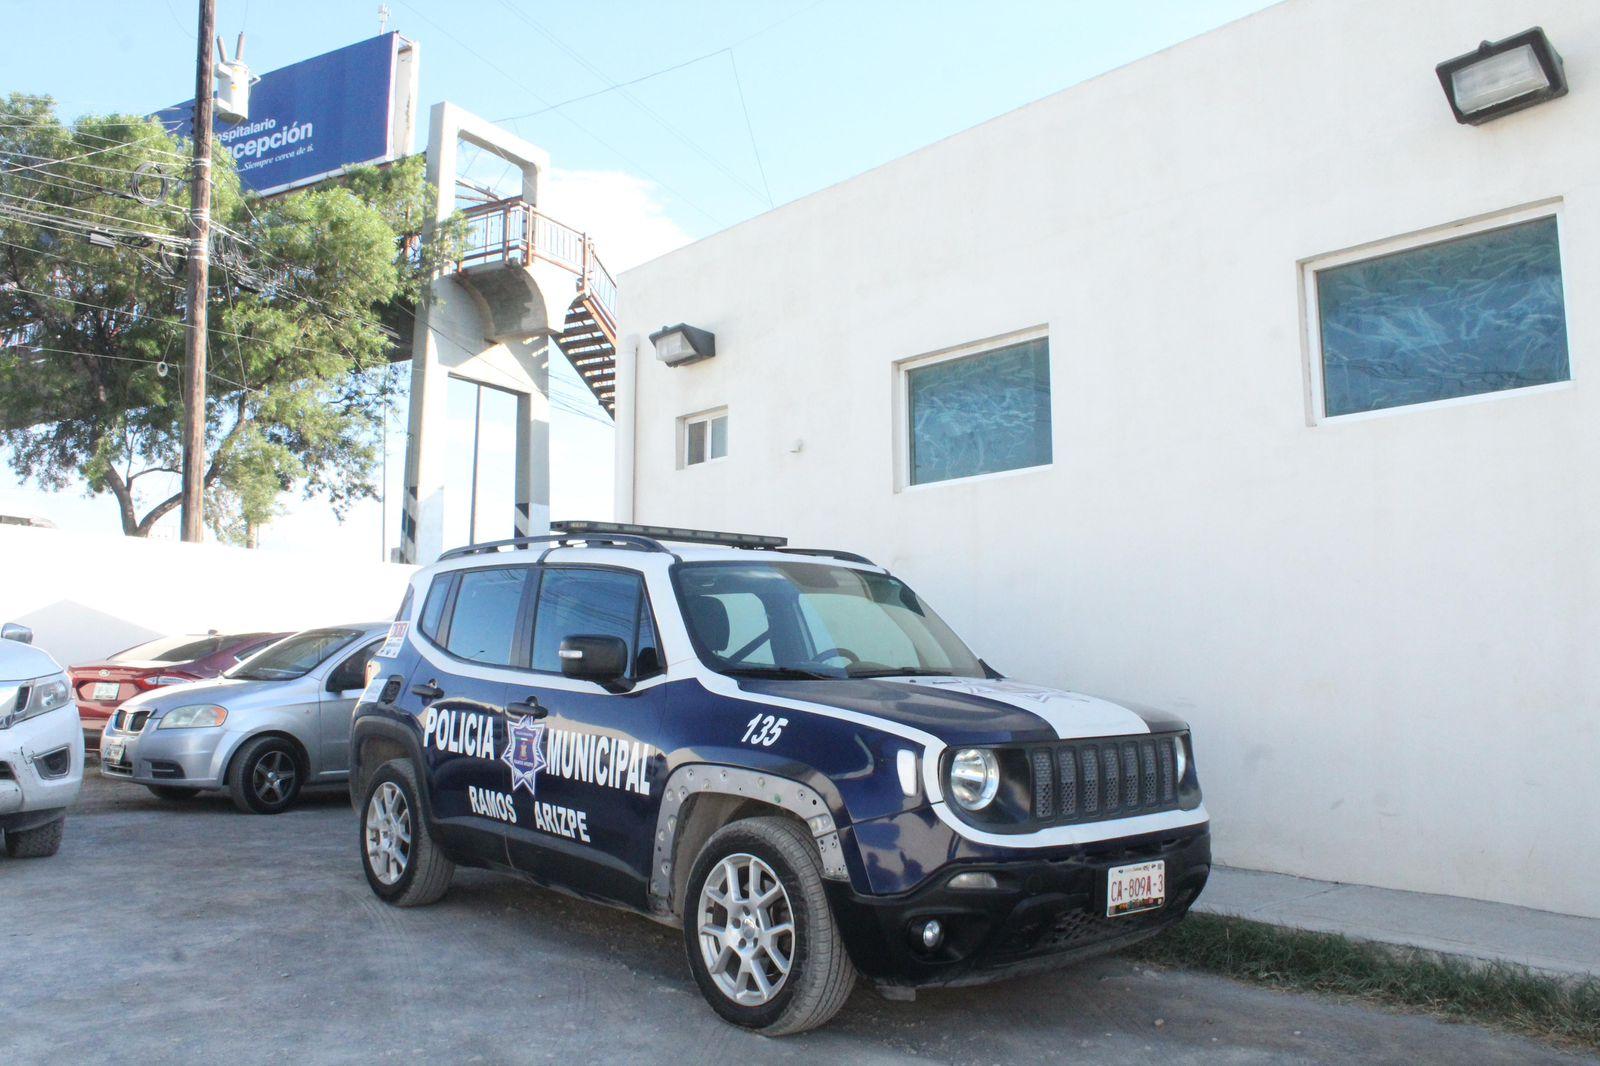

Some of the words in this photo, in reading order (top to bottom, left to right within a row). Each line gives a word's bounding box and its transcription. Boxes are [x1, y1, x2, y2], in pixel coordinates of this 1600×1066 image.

[423, 707, 495, 761] POLICIA
[546, 728, 651, 796] MUNICIPAL
[741, 713, 789, 747] 135
[468, 785, 517, 824] RAMOS
[534, 801, 591, 843] ARIZPE
